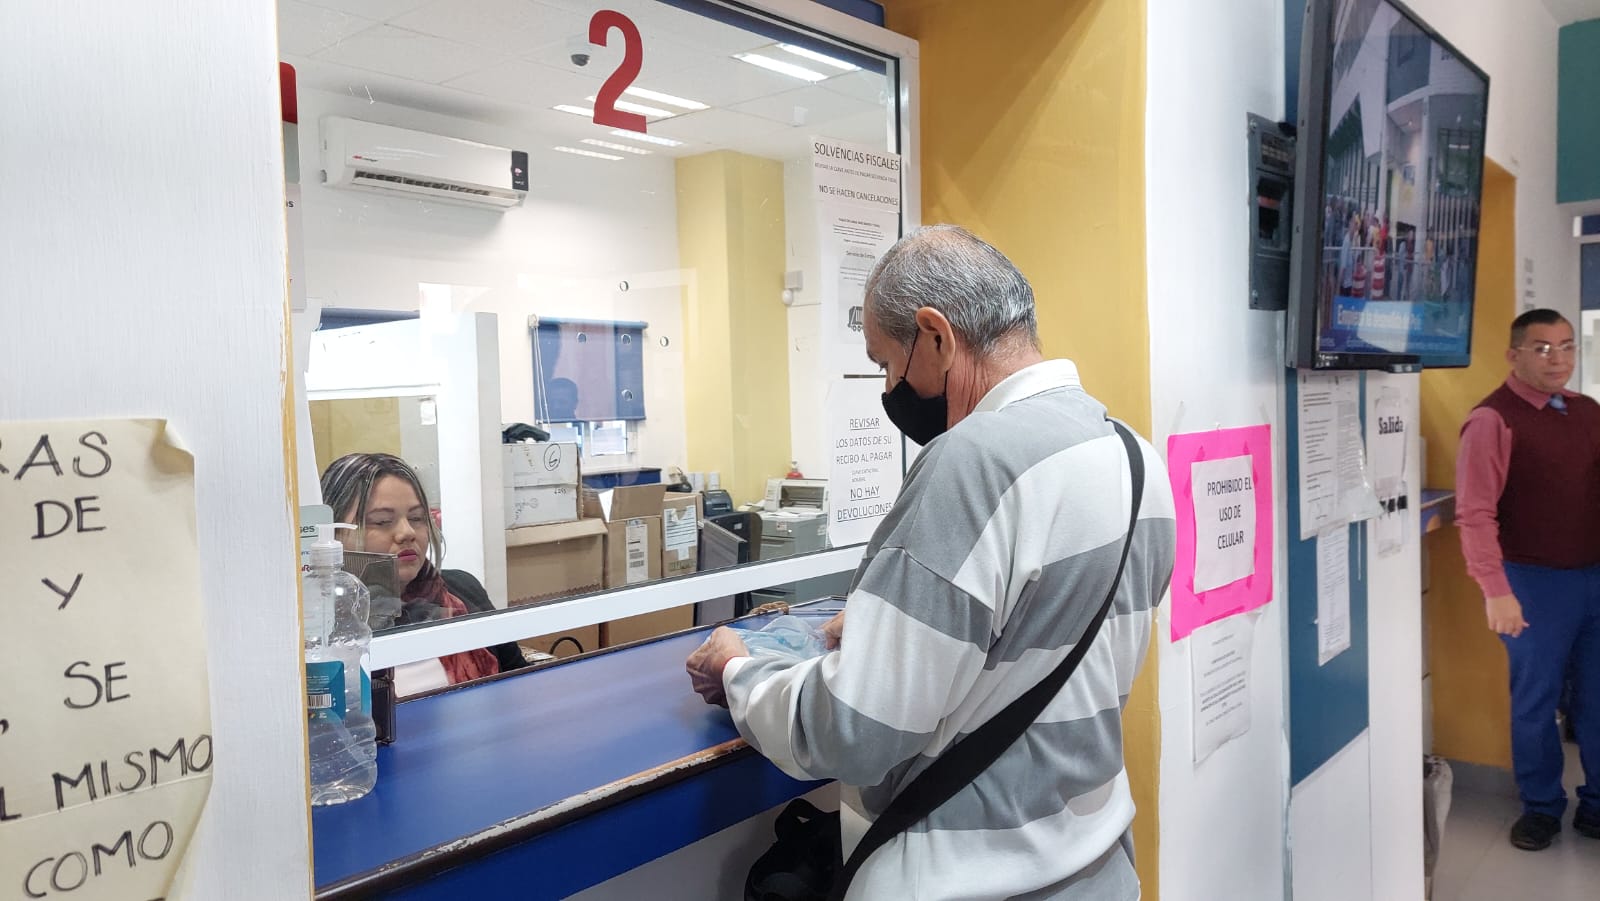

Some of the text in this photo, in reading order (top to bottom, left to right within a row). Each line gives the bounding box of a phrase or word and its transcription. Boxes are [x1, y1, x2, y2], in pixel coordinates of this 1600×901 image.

[588, 10, 648, 134] 2
[814, 142, 900, 171] SOLVENCIAS FISCALES
[819, 184, 898, 206] NO SE HACEN CANCELACIONES
[850, 417, 880, 428] REVISAR
[1378, 415, 1404, 435] Salida
[836, 434, 892, 448] LOS DATOS DE SU
[836, 451, 893, 465] RECIBO AL PAGAR
[850, 486, 880, 499] NO HAY
[1207, 476, 1252, 496] PROHIBIDO EL
[31, 496, 108, 540] DE
[837, 502, 893, 521] DEVOLUCIONES
[1219, 504, 1242, 522] USO DE
[1217, 530, 1245, 550] CELULAR
[41, 573, 84, 610] Y
[63, 661, 131, 709] SE
[52, 734, 214, 810] MISMO
[22, 821, 174, 899] COMO
